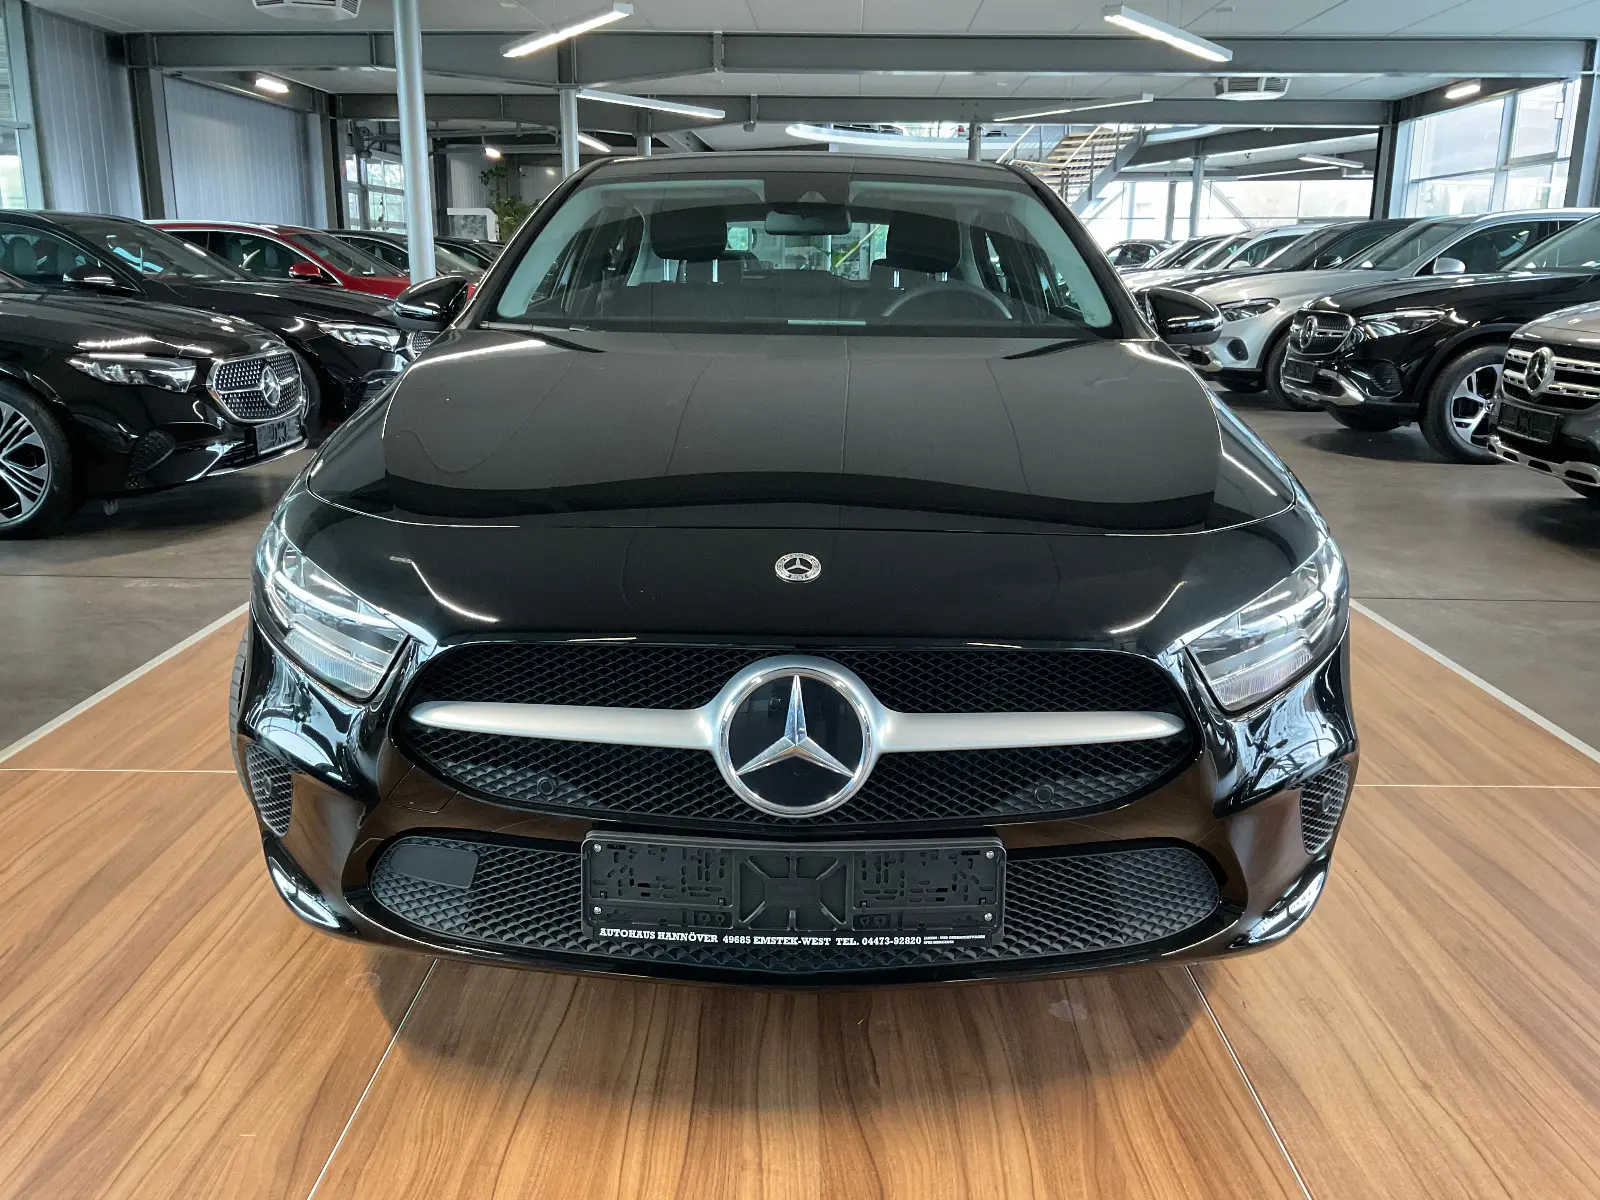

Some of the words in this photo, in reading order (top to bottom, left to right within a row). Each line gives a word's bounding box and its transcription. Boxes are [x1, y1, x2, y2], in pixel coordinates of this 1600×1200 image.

[599, 928, 655, 940] AUTOHAUS
[657, 931, 718, 943] HANNÖVER
[722, 935, 751, 944] 49685
[753, 936, 831, 945] EMSTEK-WEST
[836, 937, 859, 945] TEL.
[861, 936, 922, 945] 04473-92820
